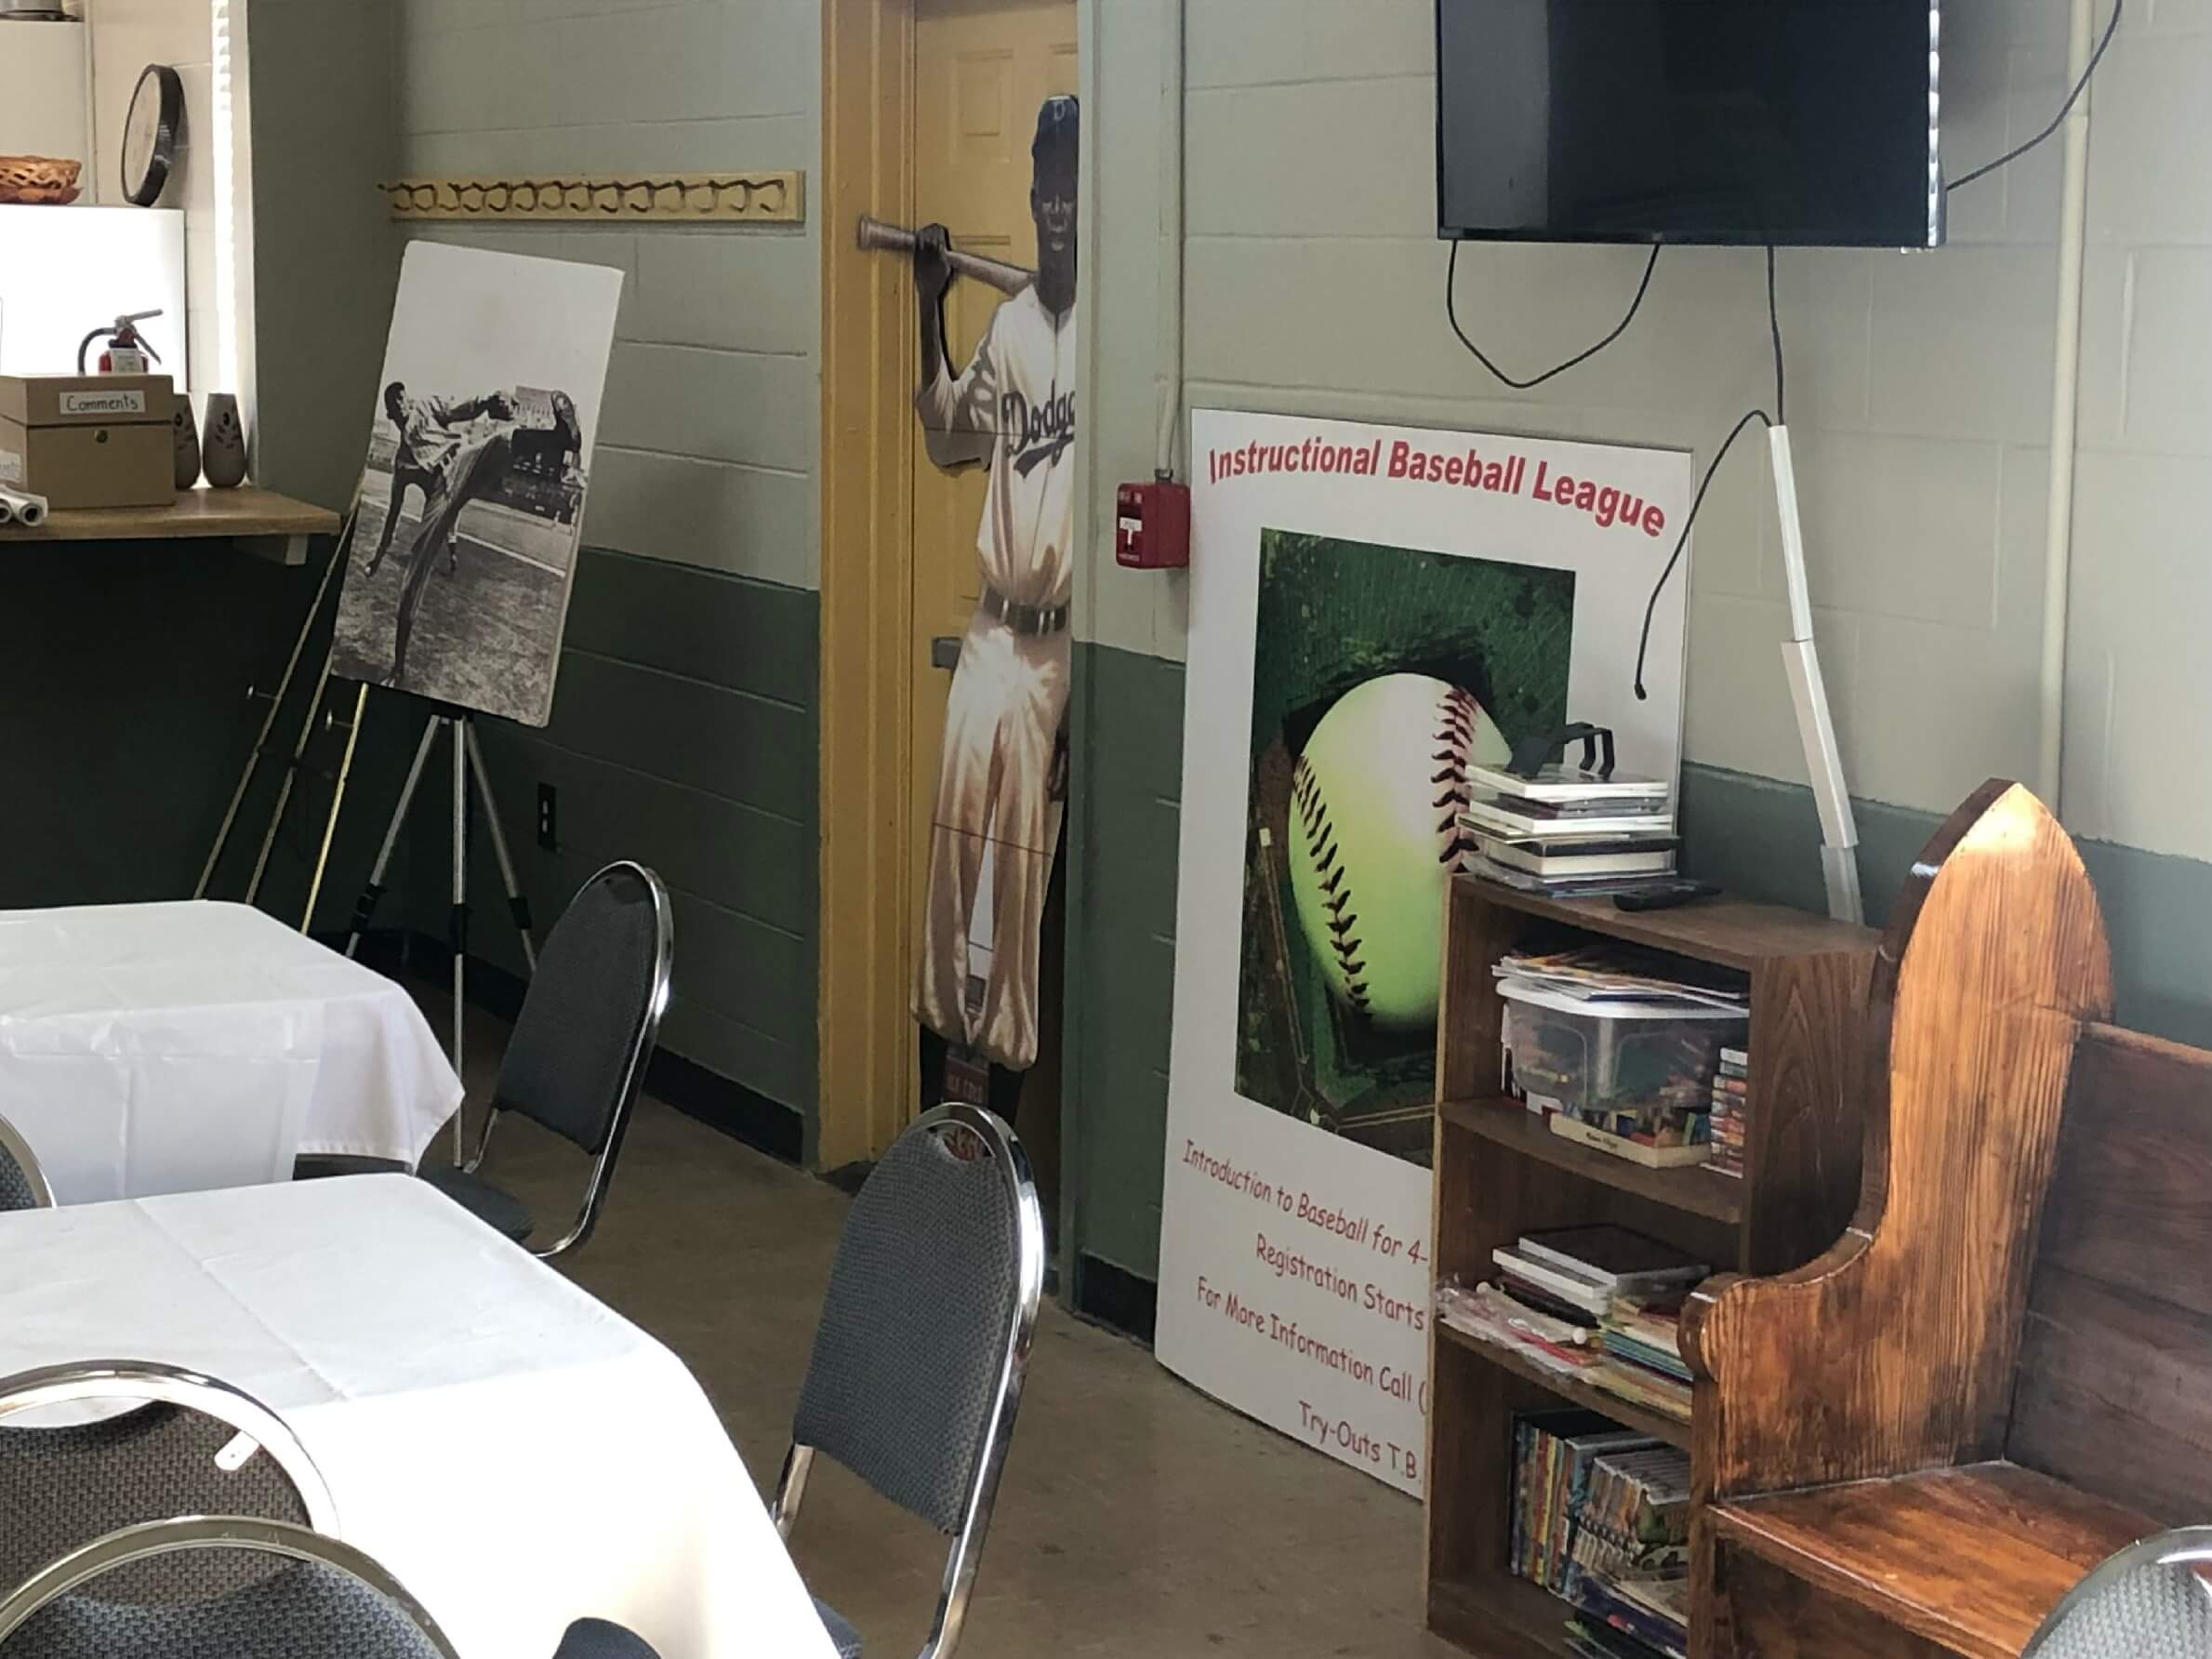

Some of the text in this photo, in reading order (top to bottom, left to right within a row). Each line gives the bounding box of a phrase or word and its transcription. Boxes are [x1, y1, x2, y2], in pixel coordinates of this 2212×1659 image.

[66, 393, 139, 412] Comments
[1210, 436, 1666, 538] Instructional Baseball League
[1183, 1138, 1272, 1203] Introduction
[1277, 1186, 1293, 1213] to
[1297, 1192, 1370, 1244] Baseball
[1372, 1224, 1403, 1257] for
[1256, 1233, 1425, 1331] Registration Starts
[1197, 1275, 1222, 1309] For
[1225, 1291, 1265, 1334] More
[1269, 1313, 1373, 1386] Information
[1379, 1366, 1412, 1402] Call
[1299, 1400, 1381, 1463] Try-Outs
